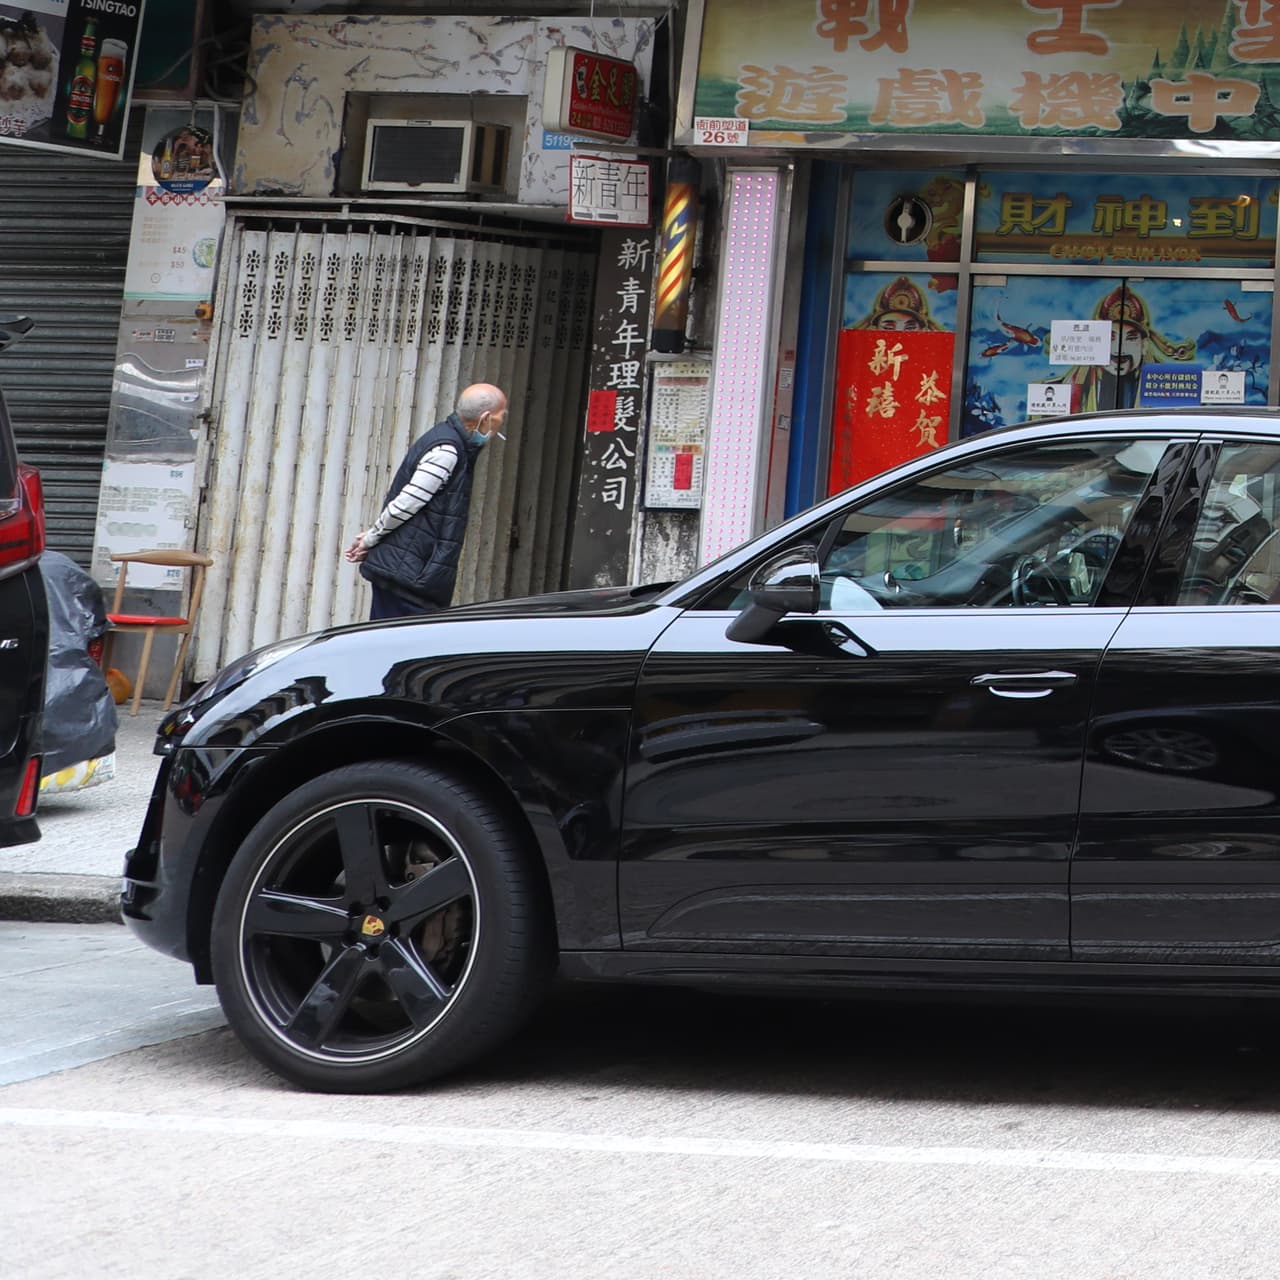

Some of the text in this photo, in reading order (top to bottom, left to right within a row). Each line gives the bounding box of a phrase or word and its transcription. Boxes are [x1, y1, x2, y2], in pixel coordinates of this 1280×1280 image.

[703, 131, 740, 144] 26號
[573, 160, 648, 210] 新青年
[996, 191, 1261, 241] 財神到
[601, 236, 651, 511] 新青年理髮公司
[865, 338, 909, 419] 新禧
[909, 370, 947, 449] 恭賀
